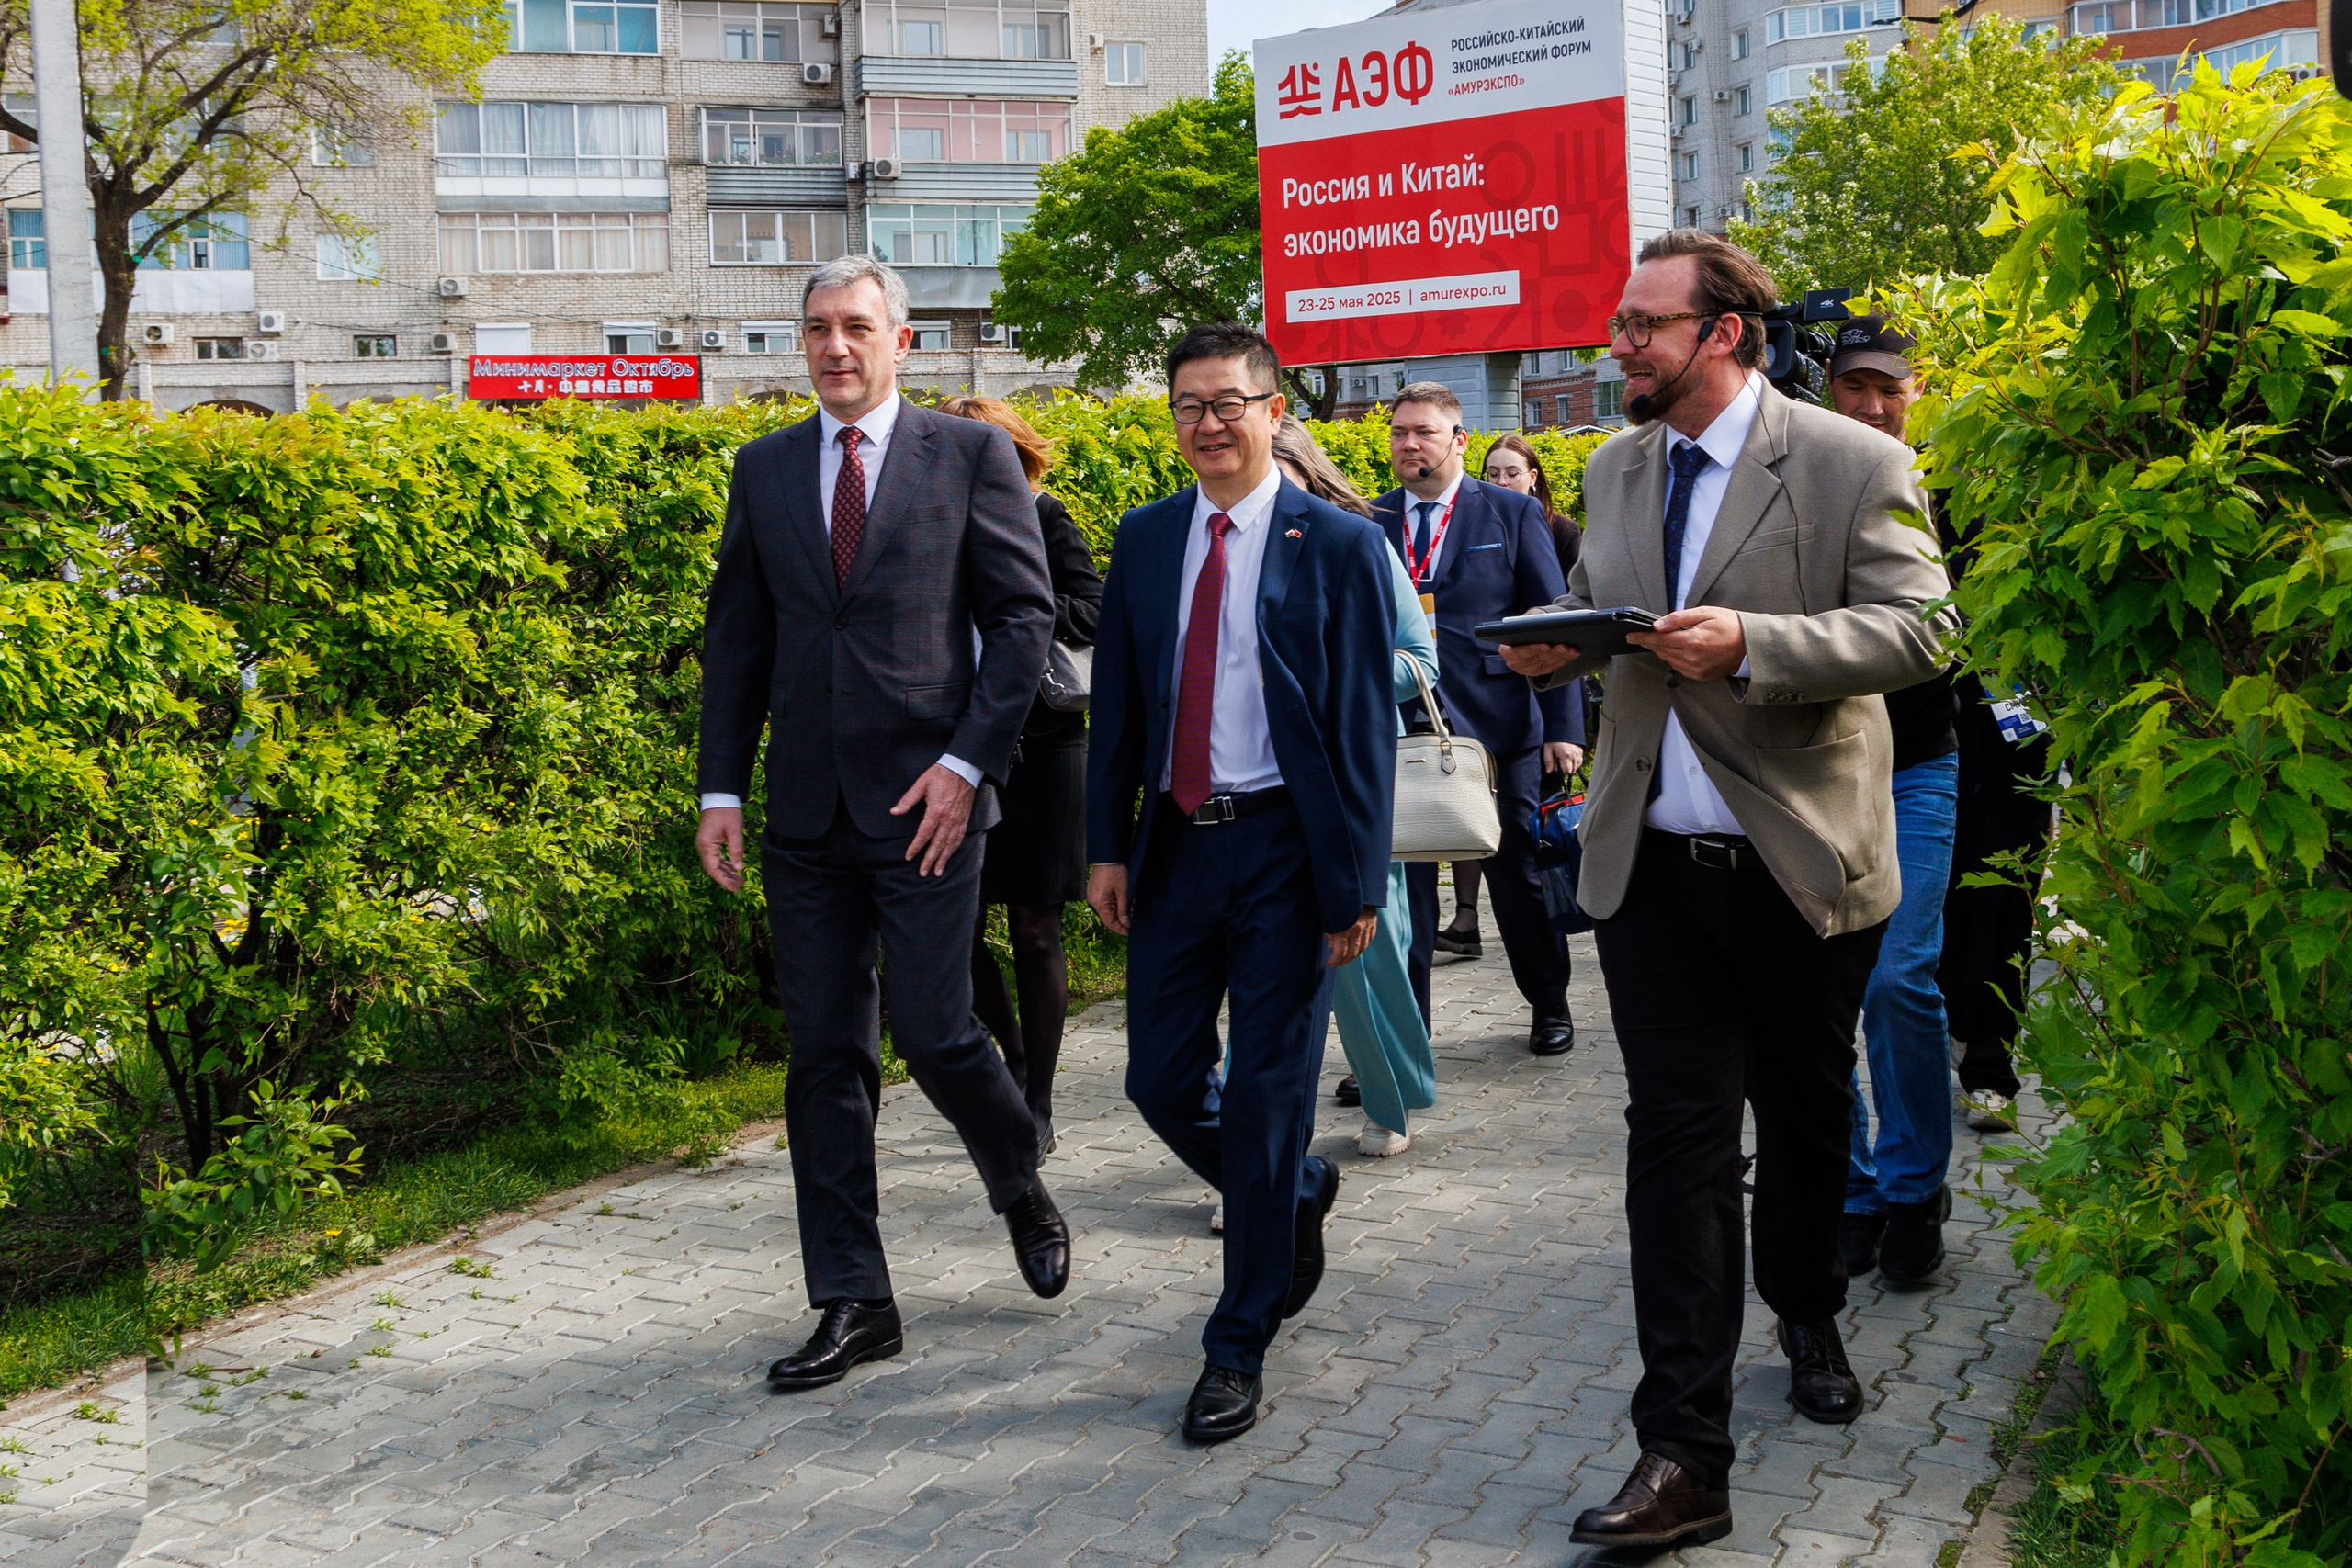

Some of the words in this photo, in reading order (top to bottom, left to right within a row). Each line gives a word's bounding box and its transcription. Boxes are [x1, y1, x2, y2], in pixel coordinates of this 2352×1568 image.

[1451, 16, 1586, 52] РОССИЙСКО-КИТАЙСКИЙ
[1452, 46, 1548, 74] ЭКОНОМИЧЕСКИЙ
[1550, 39, 1592, 60] ФОРУМ
[1331, 40, 1434, 113] АЭФ
[1447, 75, 1525, 96] «АМУРЭКСПО»
[1283, 175, 1370, 209] Россия
[1378, 173, 1393, 197] и
[1401, 154, 1486, 195] Китай:
[1283, 220, 1420, 257] экономика
[1429, 204, 1559, 249] будущего
[1297, 296, 1335, 313] 23-25
[1339, 295, 1363, 310] мая
[1366, 290, 1401, 306] 2025
[1419, 283, 1507, 303] amurexpo.ru
[473, 358, 605, 379] Минимаркет
[612, 358, 695, 379] Октябрь
